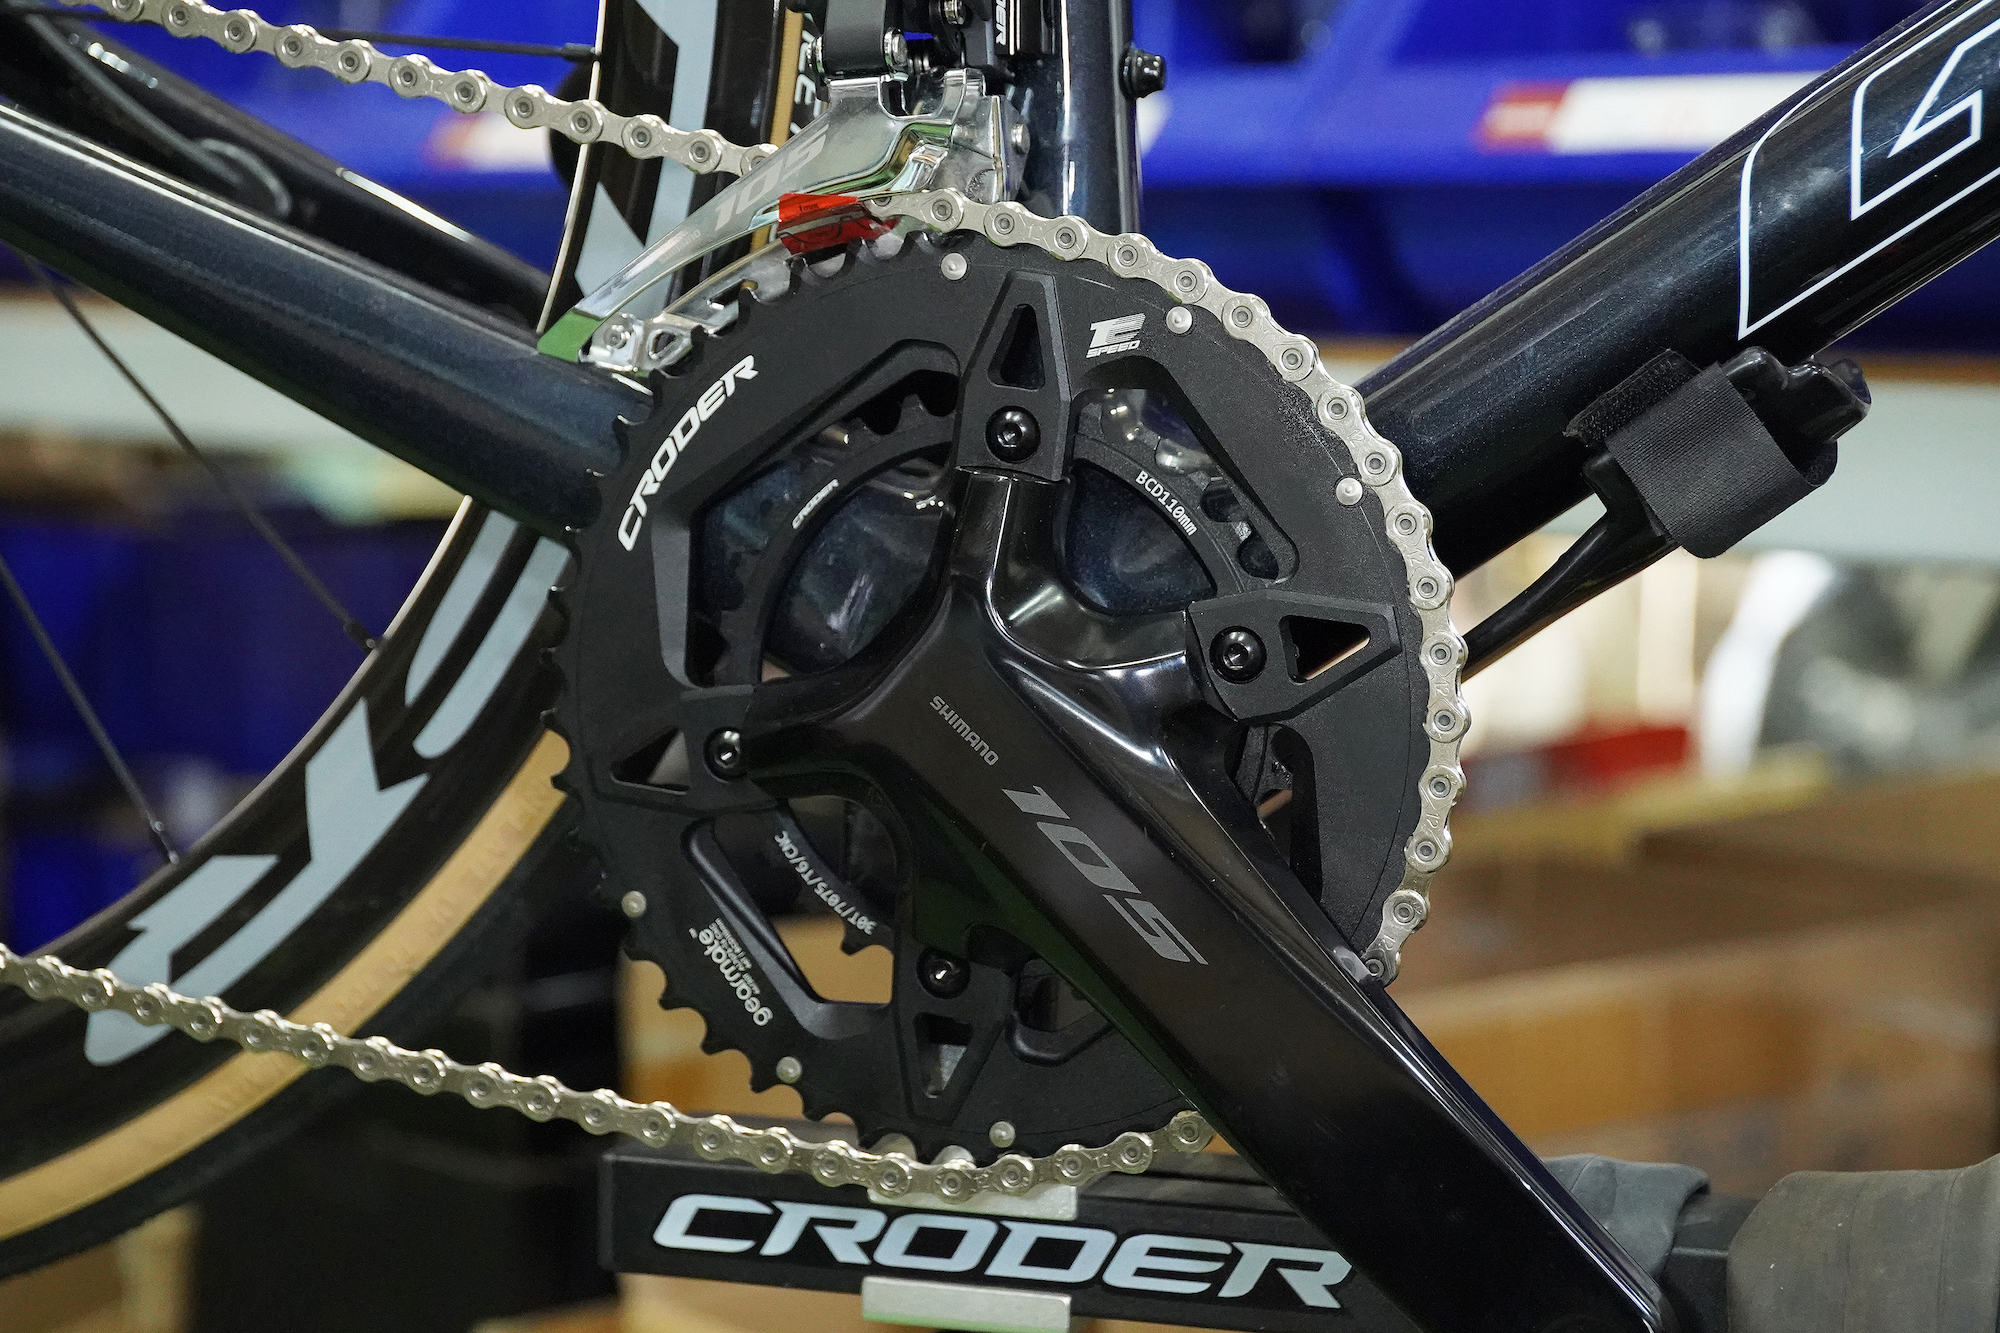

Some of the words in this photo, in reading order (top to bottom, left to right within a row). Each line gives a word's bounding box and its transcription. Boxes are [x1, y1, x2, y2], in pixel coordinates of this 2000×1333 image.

[714, 123, 830, 232] 105
[1085, 339, 1141, 359] SPEED
[617, 354, 759, 552] CRODER
[1134, 469, 1198, 537] BCD110mm
[791, 477, 840, 530] CRODER
[928, 694, 1000, 767] SHIMANO
[1001, 784, 1209, 966] 105
[698, 927, 774, 1027] gearmate
[652, 1193, 1354, 1310] CRODER
